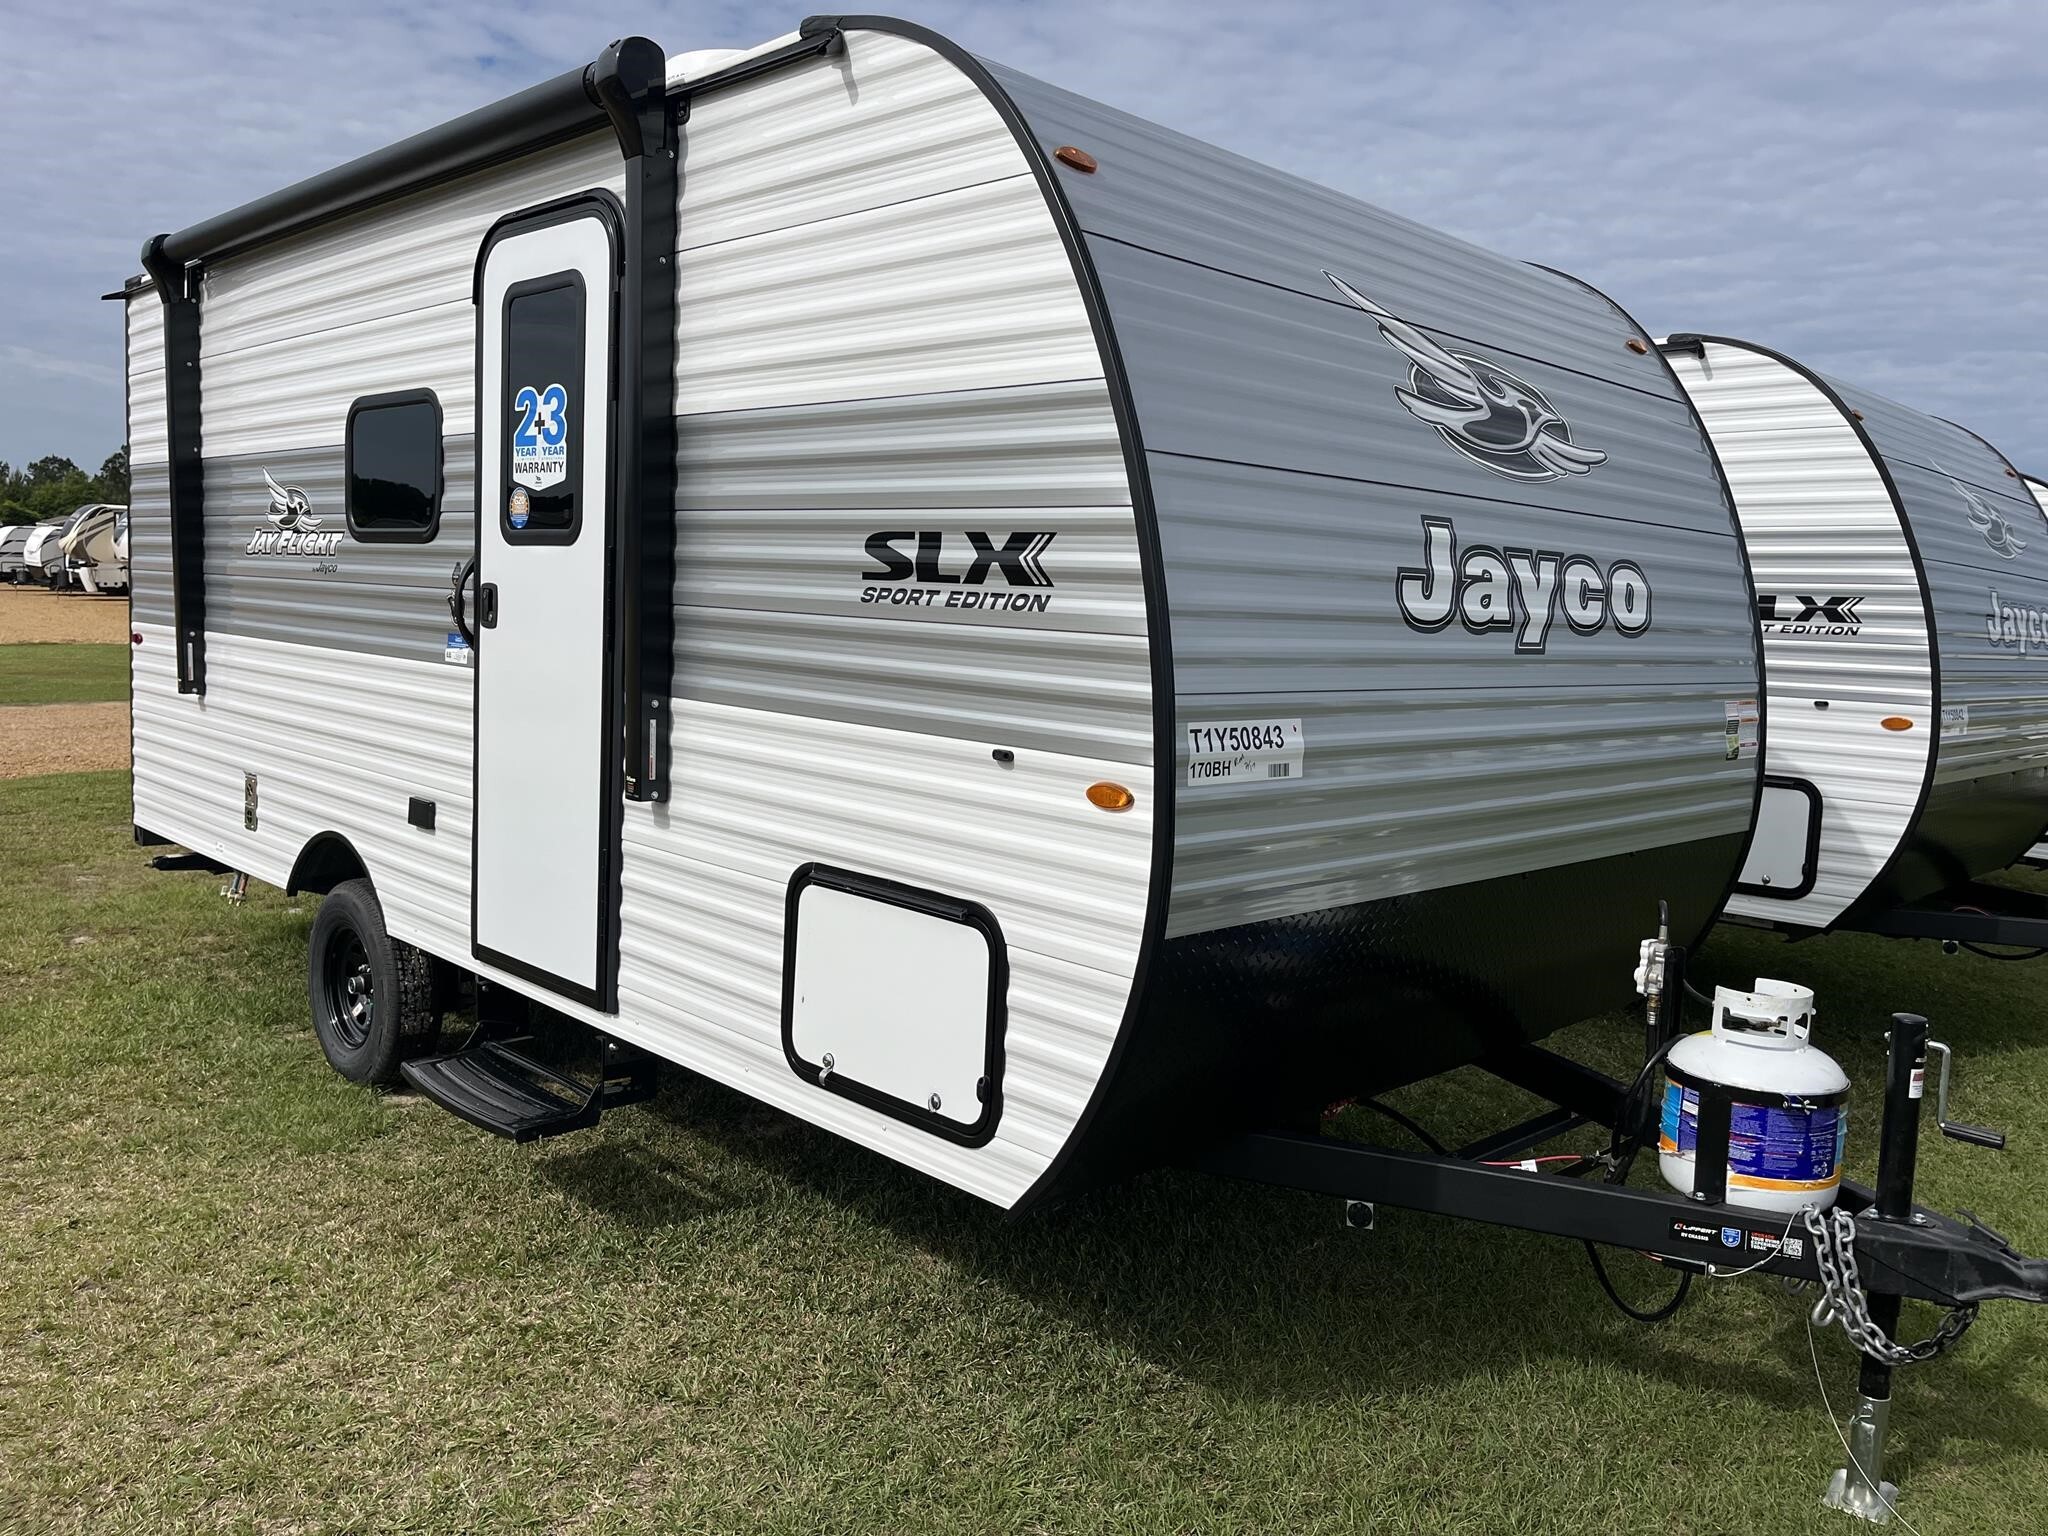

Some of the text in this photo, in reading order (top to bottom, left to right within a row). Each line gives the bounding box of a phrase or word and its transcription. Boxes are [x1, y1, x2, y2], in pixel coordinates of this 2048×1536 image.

[515, 446, 565, 457] YEAR YEAR
[515, 461, 565, 474] WARRANTY
[245, 527, 345, 557] JAY FLIGHT
[861, 530, 1058, 588] SLX
[1395, 514, 1653, 655] Jayco
[860, 586, 1052, 613] SPORT EDITION
[1780, 624, 1861, 636] EDITION
[1189, 724, 1285, 753] T1Y50843
[1189, 760, 1232, 779] 170BH
